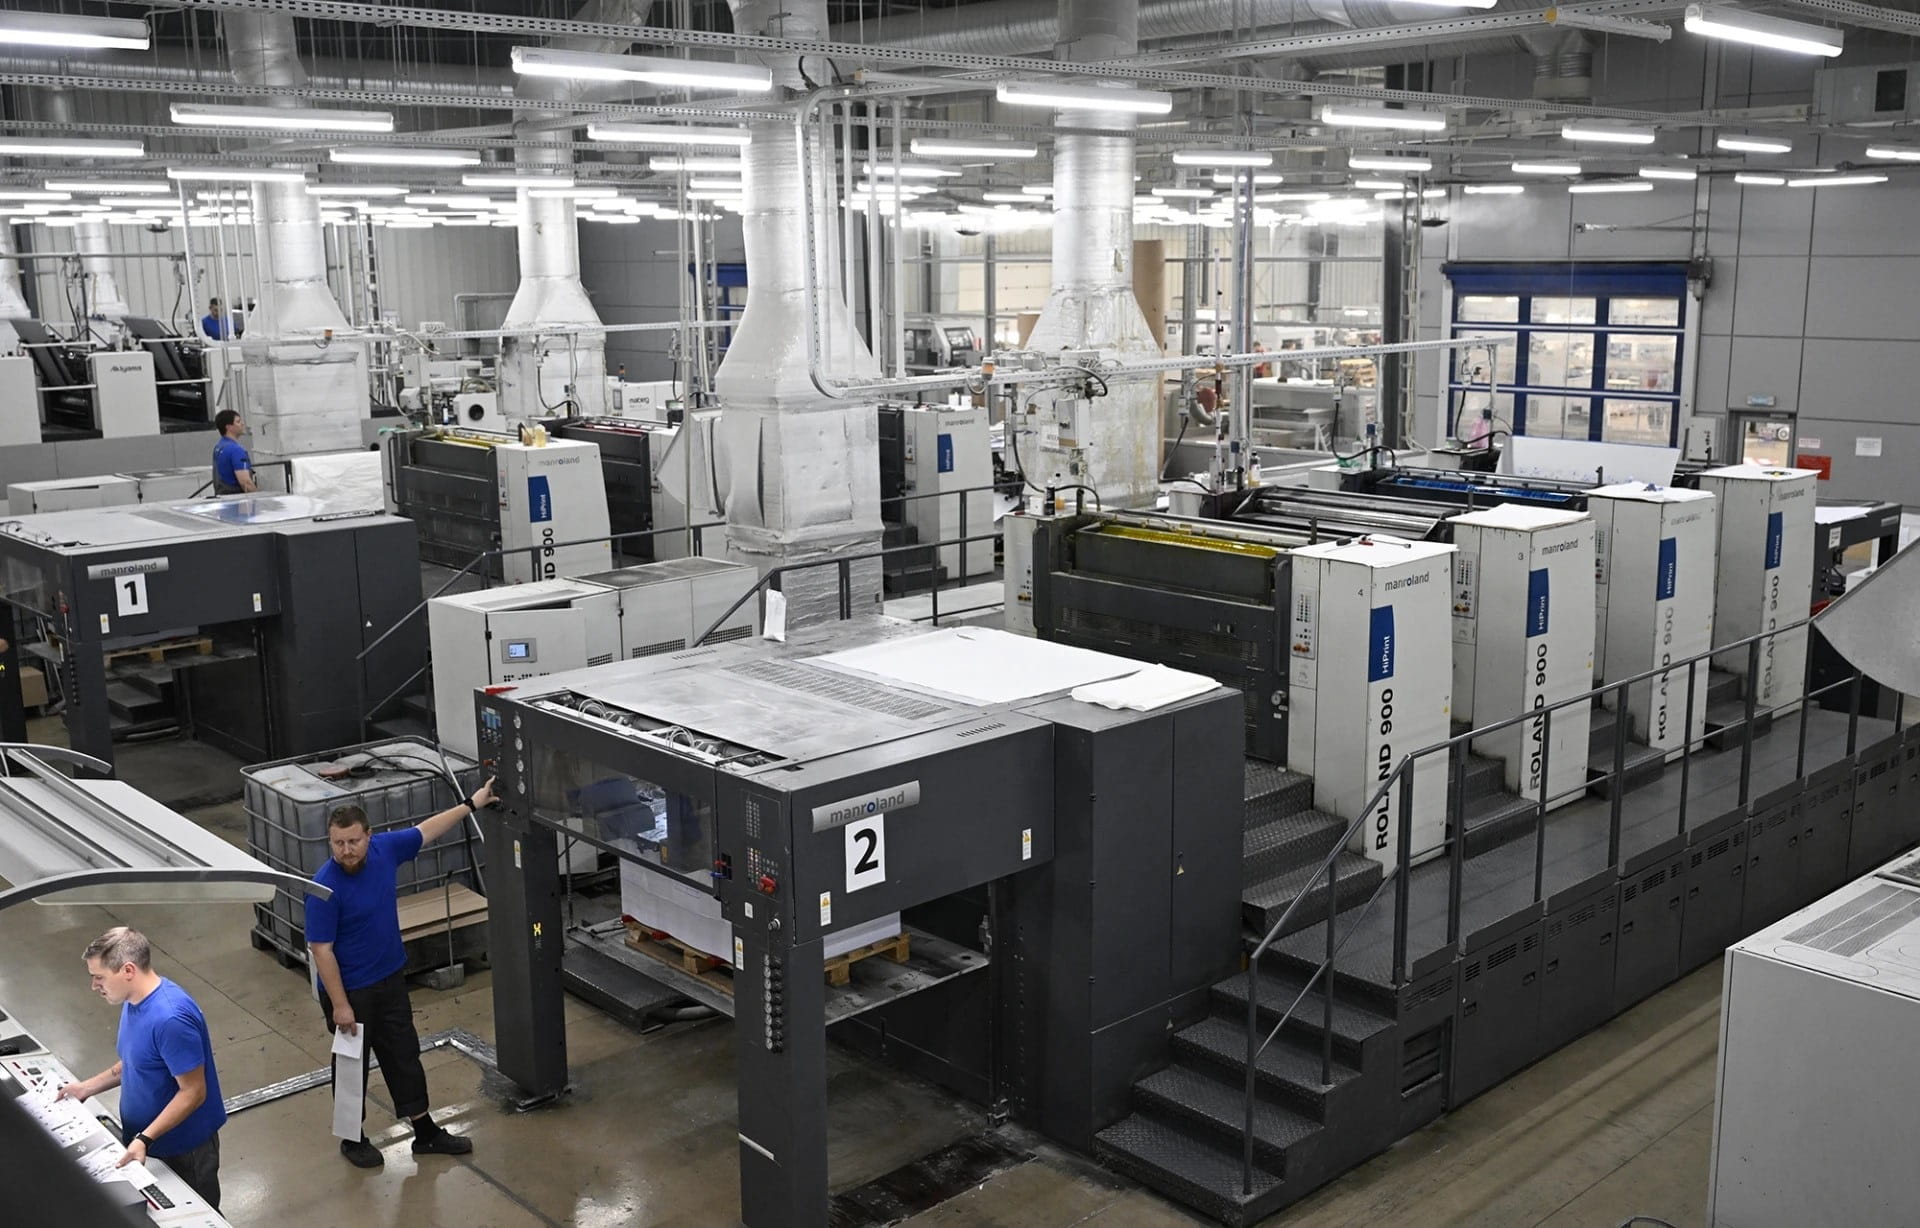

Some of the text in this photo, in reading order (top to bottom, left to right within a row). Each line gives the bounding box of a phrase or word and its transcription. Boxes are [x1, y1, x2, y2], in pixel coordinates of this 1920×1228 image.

[1542, 539, 1578, 555] manroland
[101, 562, 157, 577] manroland
[1385, 571, 1429, 591] manroland
[124, 581, 138, 606] 1
[1382, 636, 1390, 674] HiPrint
[1536, 643, 1547, 686] 900
[1380, 688, 1394, 735] 900
[830, 791, 904, 823] manroland
[854, 828, 879, 875] 2
